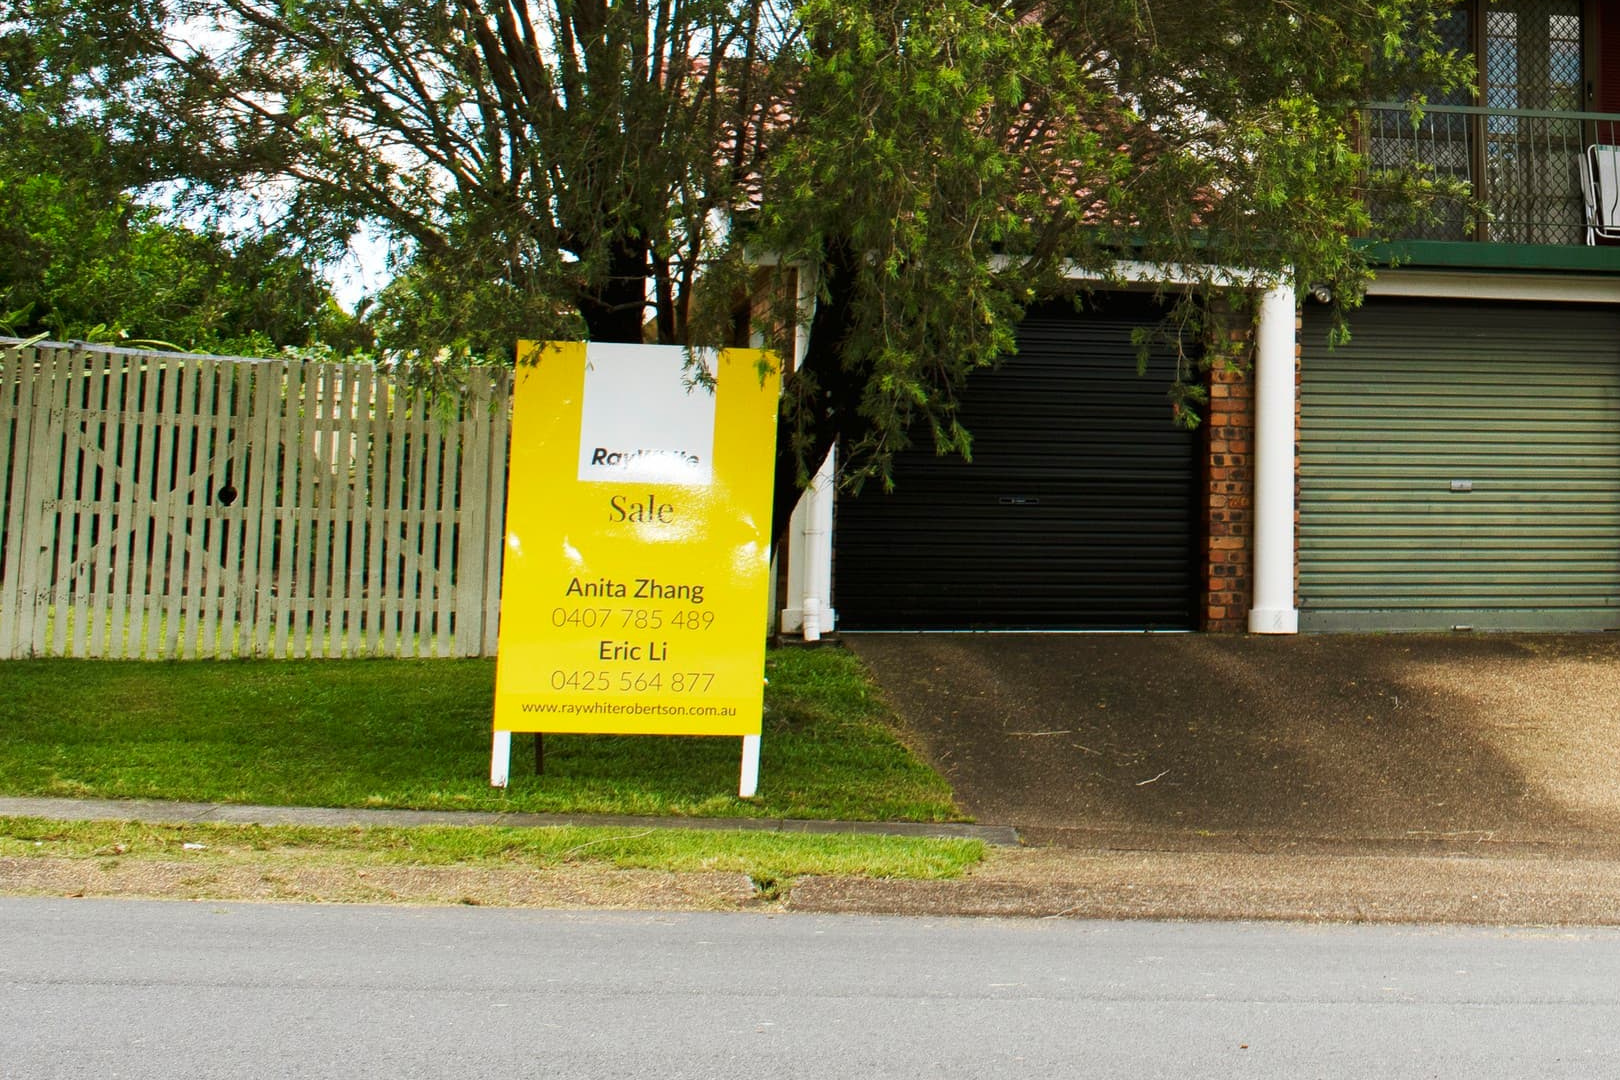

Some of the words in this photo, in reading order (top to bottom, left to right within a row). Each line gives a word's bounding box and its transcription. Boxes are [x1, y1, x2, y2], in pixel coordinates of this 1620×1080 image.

[609, 494, 674, 524] Sale
[566, 577, 627, 598] Anita
[633, 579, 704, 604] Zhang
[552, 607, 612, 628] 0407
[621, 609, 663, 630] 785
[671, 610, 715, 631] 489
[599, 641, 641, 661] Eric
[649, 642, 667, 662] Li
[551, 670, 610, 691] 0425
[619, 671, 663, 692] 564
[671, 672, 715, 693] 877
[521, 701, 737, 717] www.raywhiterobertson.com.au
